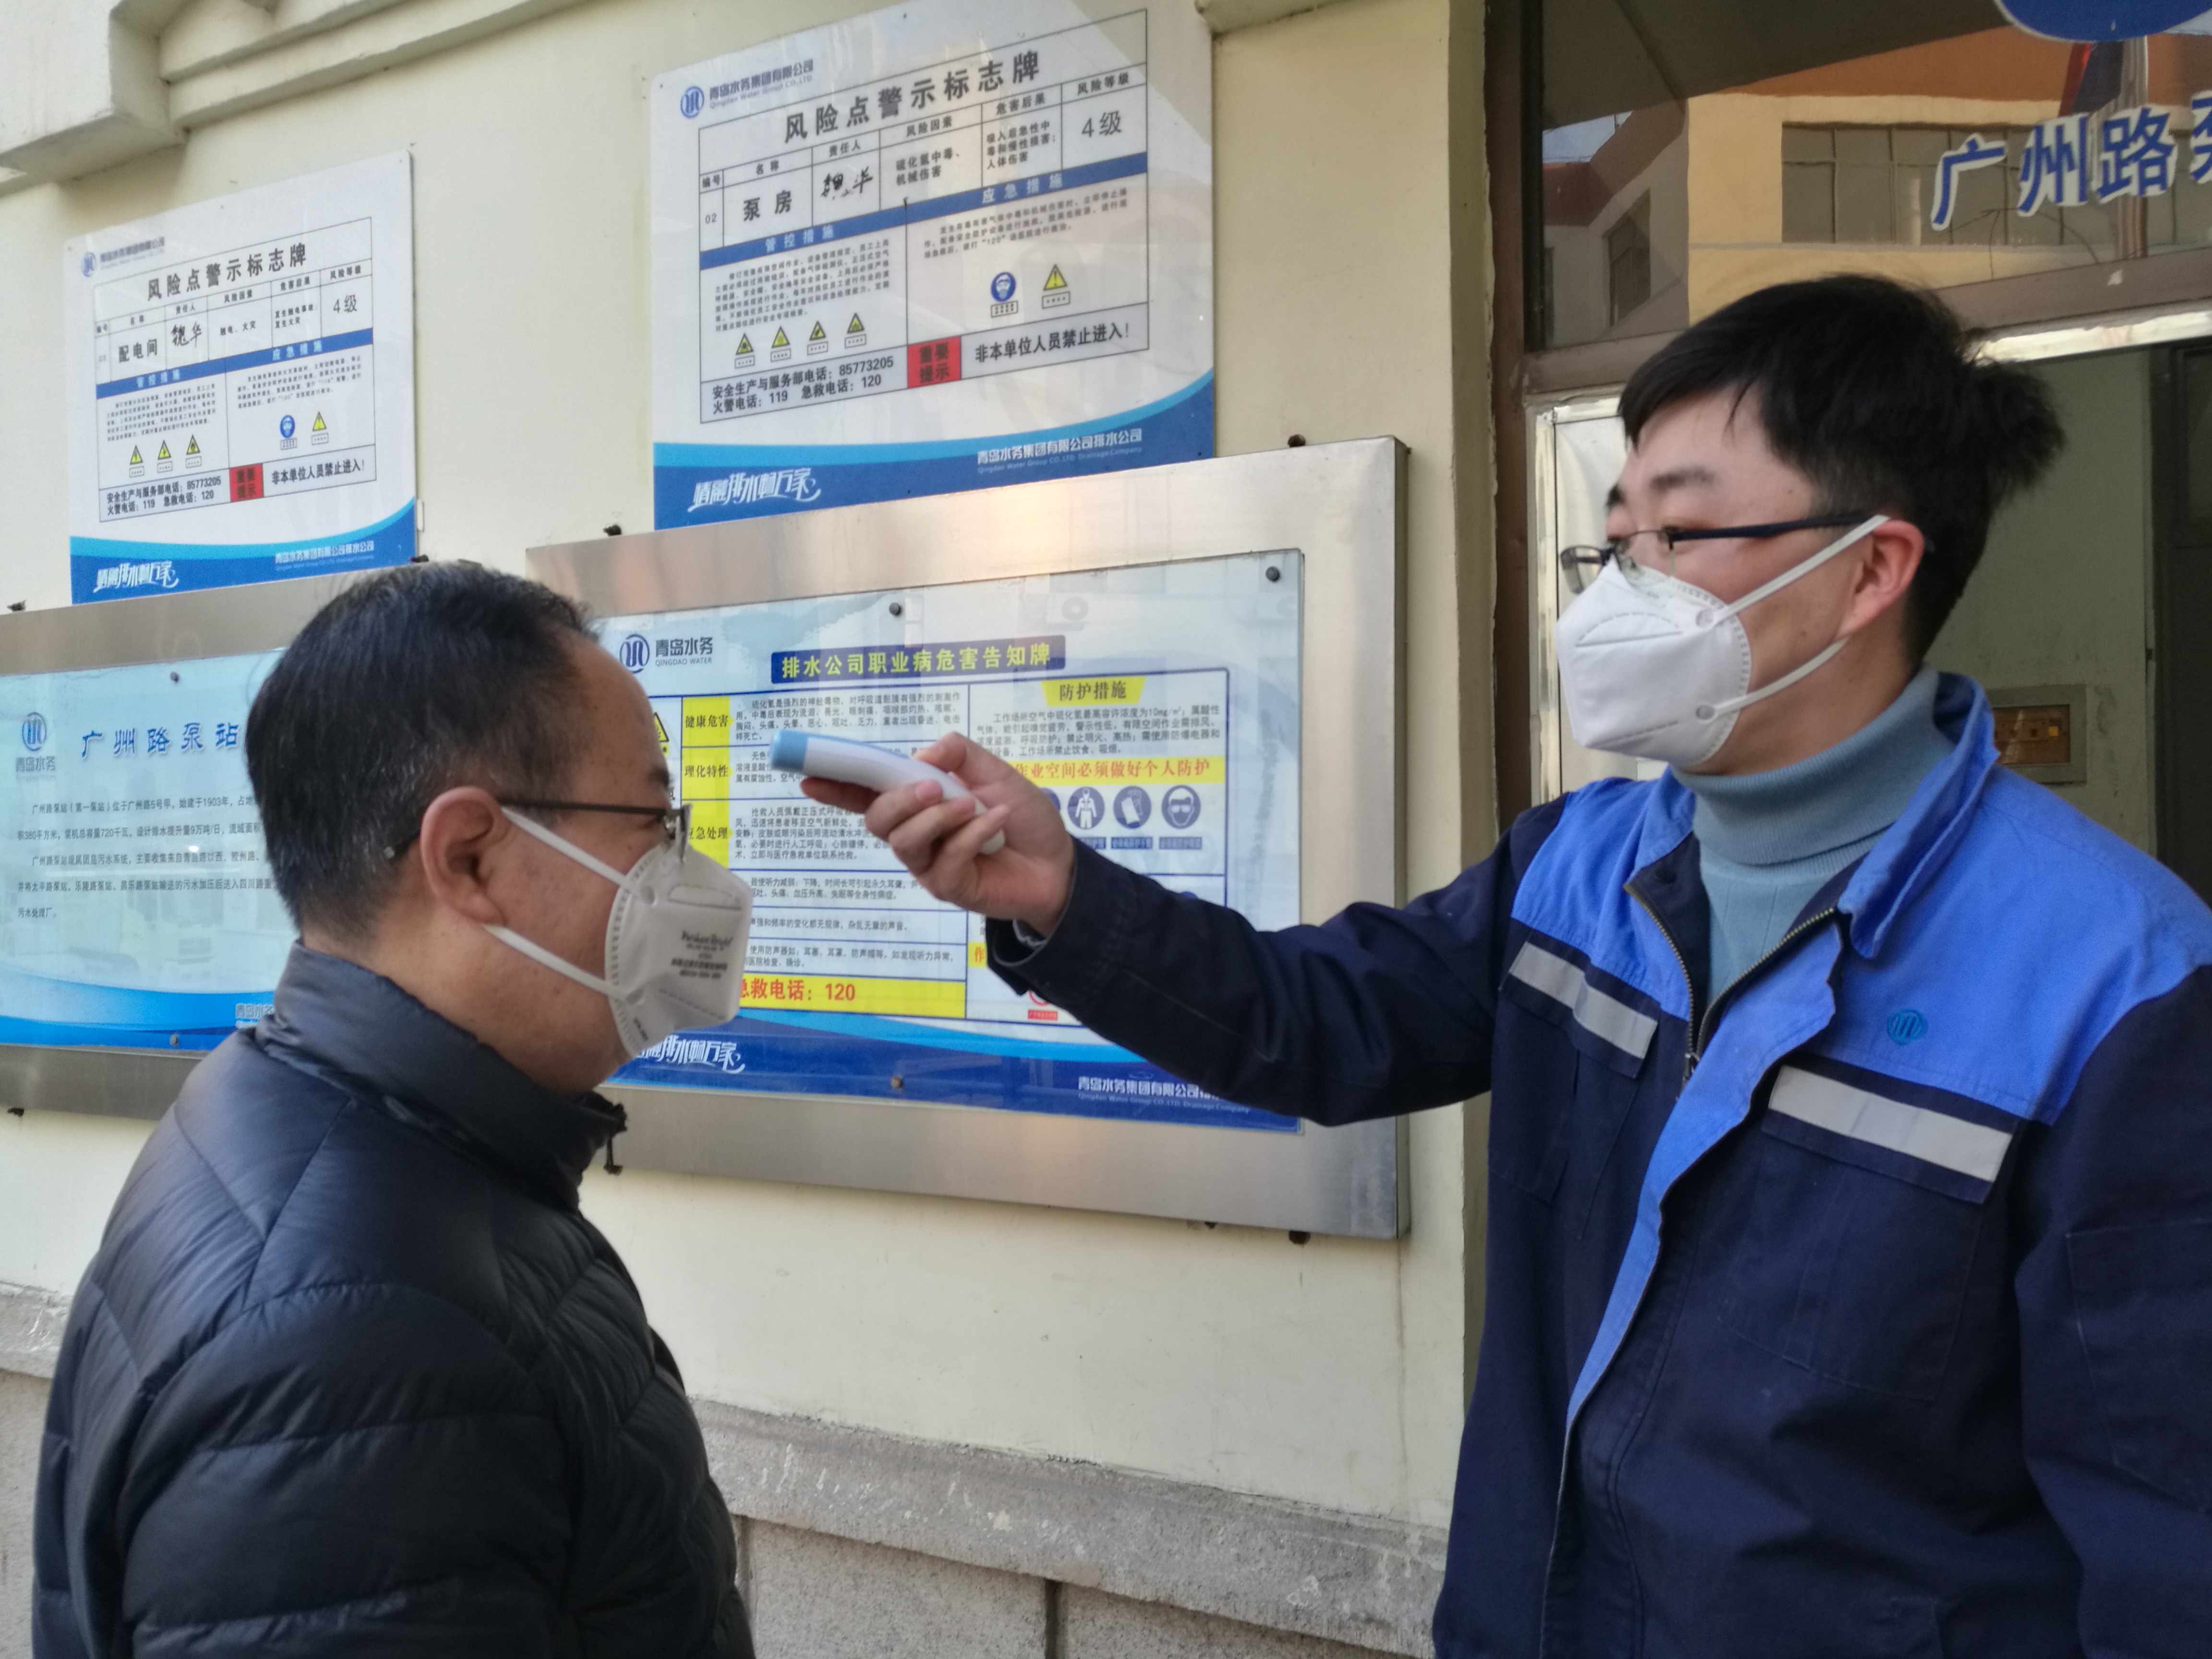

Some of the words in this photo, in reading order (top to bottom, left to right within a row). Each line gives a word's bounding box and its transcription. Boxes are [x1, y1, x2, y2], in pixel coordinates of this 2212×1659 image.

[1077, 72, 1129, 95] 风险等级
[741, 89, 760, 100] Water
[784, 51, 1039, 143] 风险点警示标志牌
[996, 93, 1046, 115] 危害后果
[906, 116, 952, 137] 风险因素
[1082, 111, 1121, 138] 4级
[829, 140, 860, 157] 责任人
[756, 160, 779, 175] 名称
[987, 151, 1028, 169] 人体伤害
[1931, 92, 2212, 230] 广州路
[896, 165, 941, 186] 机械伤害
[982, 174, 1063, 204] 应急措施
[744, 191, 791, 221] 泵房
[706, 214, 716, 223] 02
[766, 225, 833, 252] 管控措施
[148, 242, 306, 301] 风险点警示标志牌
[330, 265, 361, 280] 风险等级
[334, 294, 357, 313] 4级
[119, 338, 157, 363] 配电间
[655, 636, 713, 658] 青岛水务
[655, 658, 687, 666] QINGDAO
[690, 656, 712, 665] WATER
[781, 642, 1050, 679] 排水公司职业病危害告知牌
[1059, 681, 1127, 701] 防护措施
[685, 714, 728, 728] 健康危害
[82, 722, 239, 758] 广州路泵站
[16, 756, 56, 772] 青岛水务
[685, 765, 728, 778] 理化特性
[1079, 1076, 1220, 1100] 青岛水务集团有限公司
